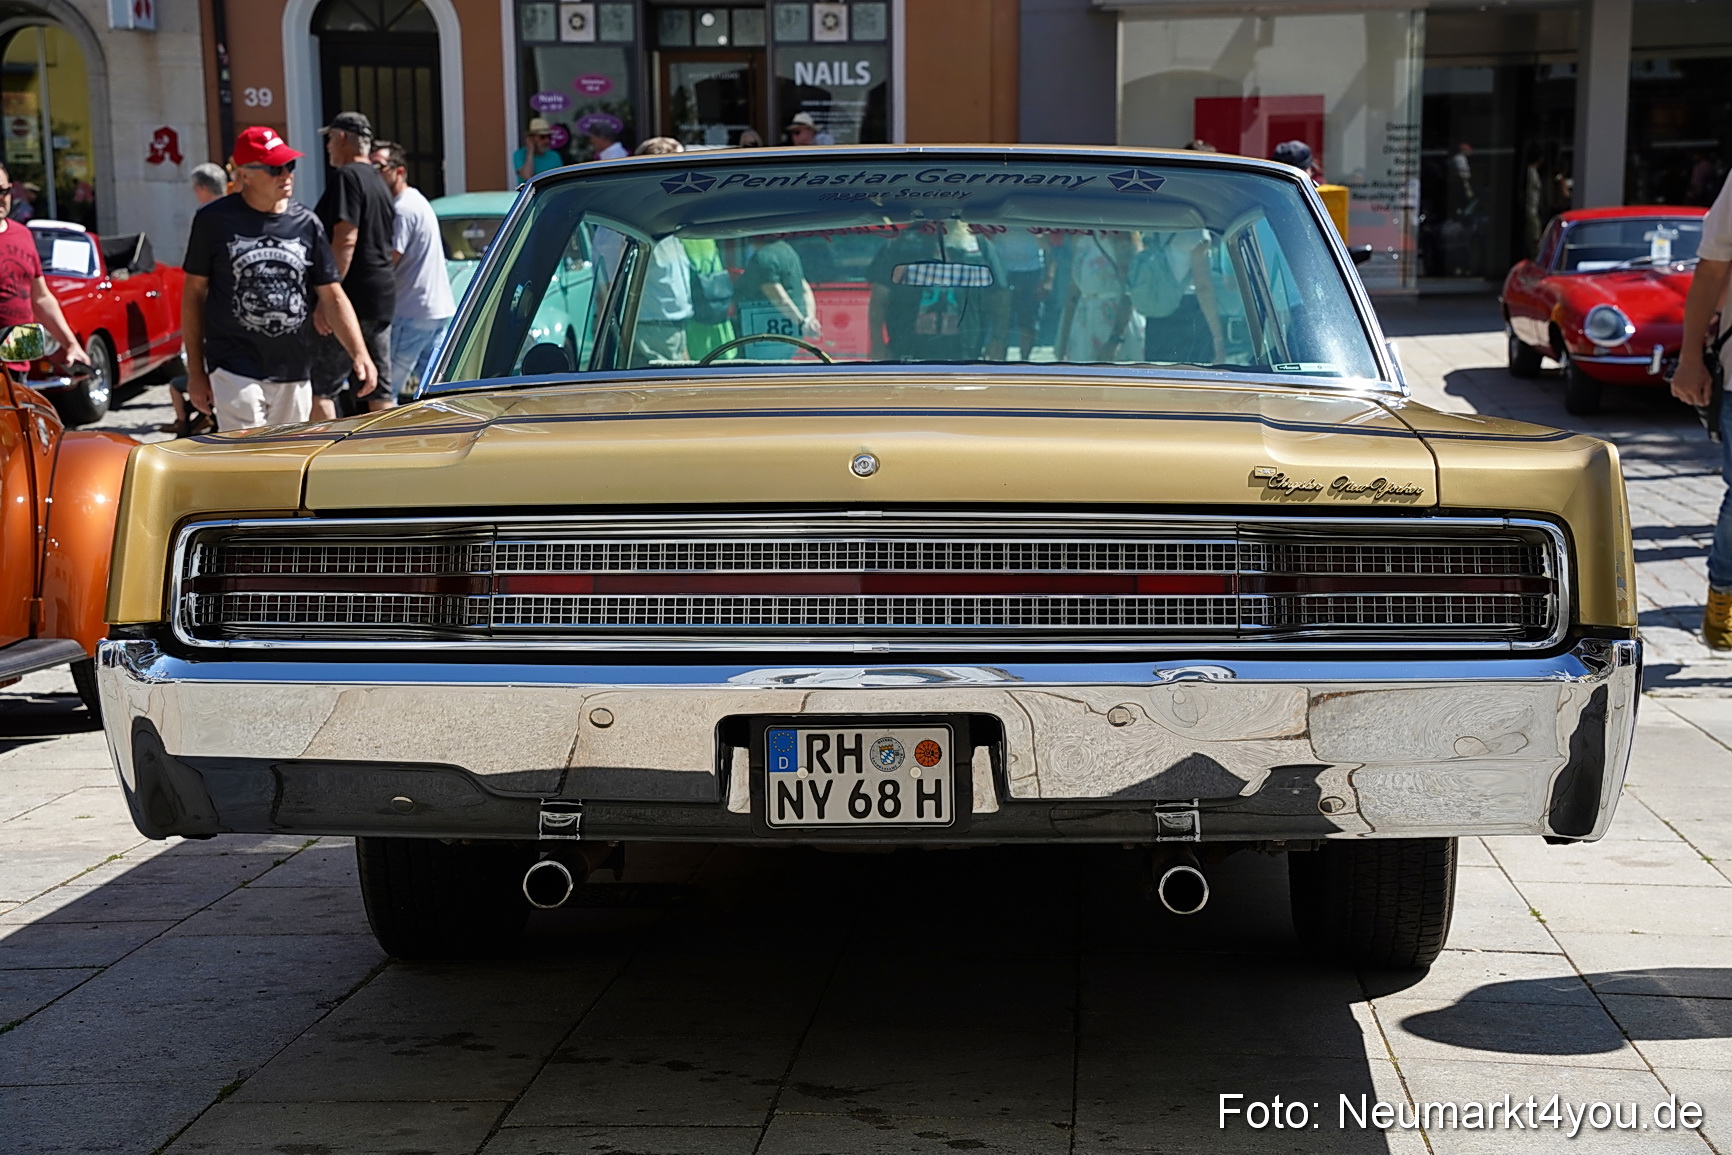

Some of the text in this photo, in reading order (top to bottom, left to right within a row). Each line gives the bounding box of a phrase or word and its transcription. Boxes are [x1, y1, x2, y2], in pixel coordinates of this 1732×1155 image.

[795, 61, 871, 86] NAILS
[244, 87, 273, 107] 39
[717, 168, 1099, 190] Pentastar Germany
[895, 188, 973, 200] Society
[1268, 472, 1425, 500] Chrysler New Yorker
[778, 733, 863, 774] D RH
[777, 778, 942, 820] NY 68 H
